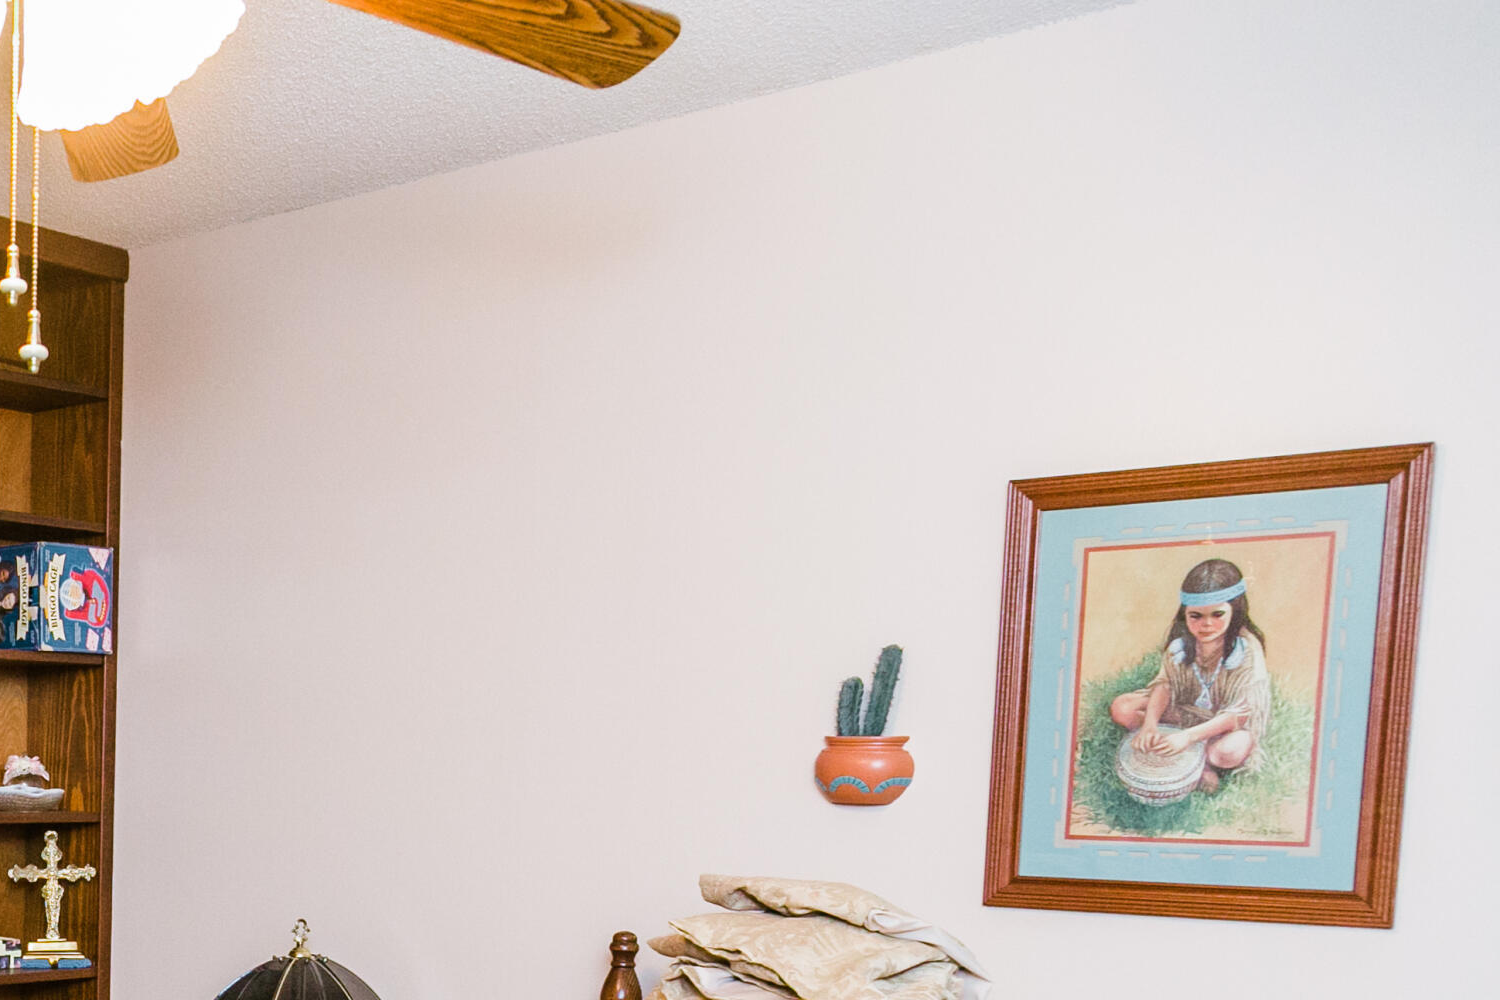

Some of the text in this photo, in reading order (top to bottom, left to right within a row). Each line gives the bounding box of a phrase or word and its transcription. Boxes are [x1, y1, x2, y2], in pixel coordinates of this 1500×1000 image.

[20, 566, 28, 600] BINGO
[49, 564, 59, 629] BINGO CAGE
